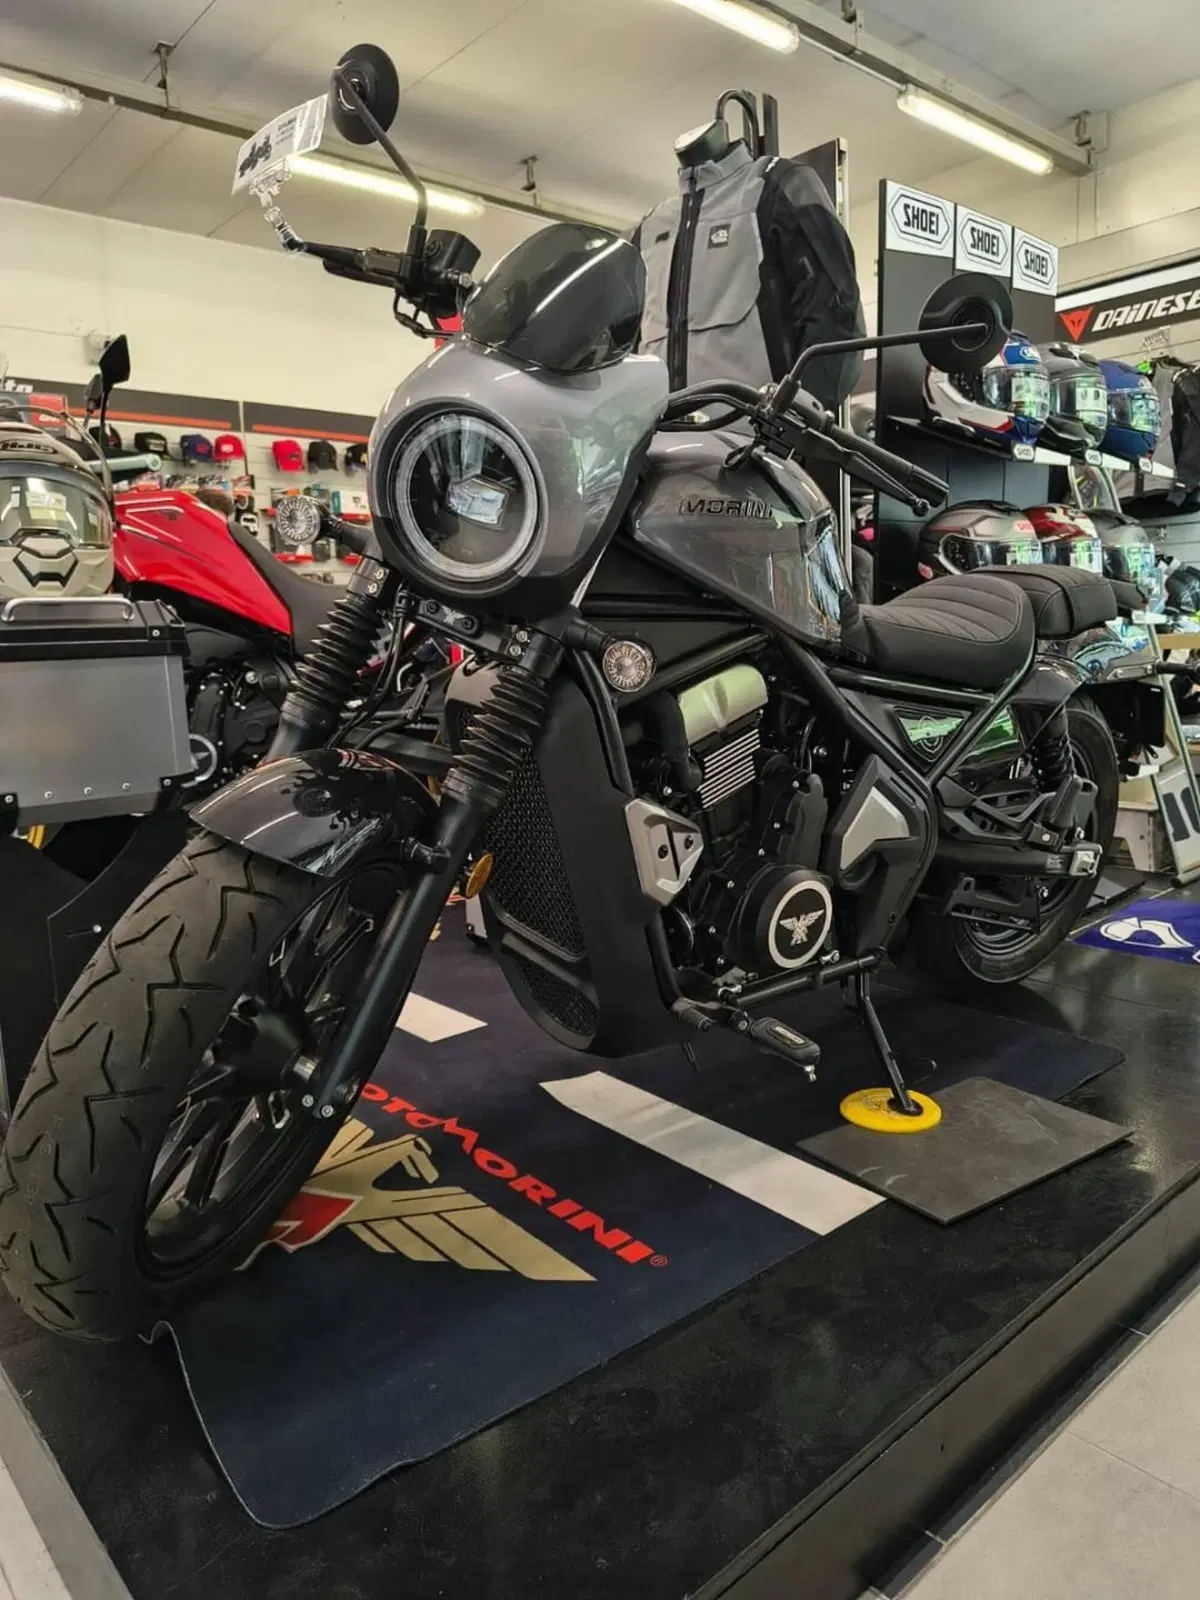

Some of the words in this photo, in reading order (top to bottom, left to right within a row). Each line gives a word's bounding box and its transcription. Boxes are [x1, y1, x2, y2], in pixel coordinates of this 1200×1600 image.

[903, 203, 939, 236] SHOEI
[969, 226, 999, 257] SHOEI
[1024, 249, 1048, 278] SHOEI
[360, 1082, 654, 1264] OTOMORINI
